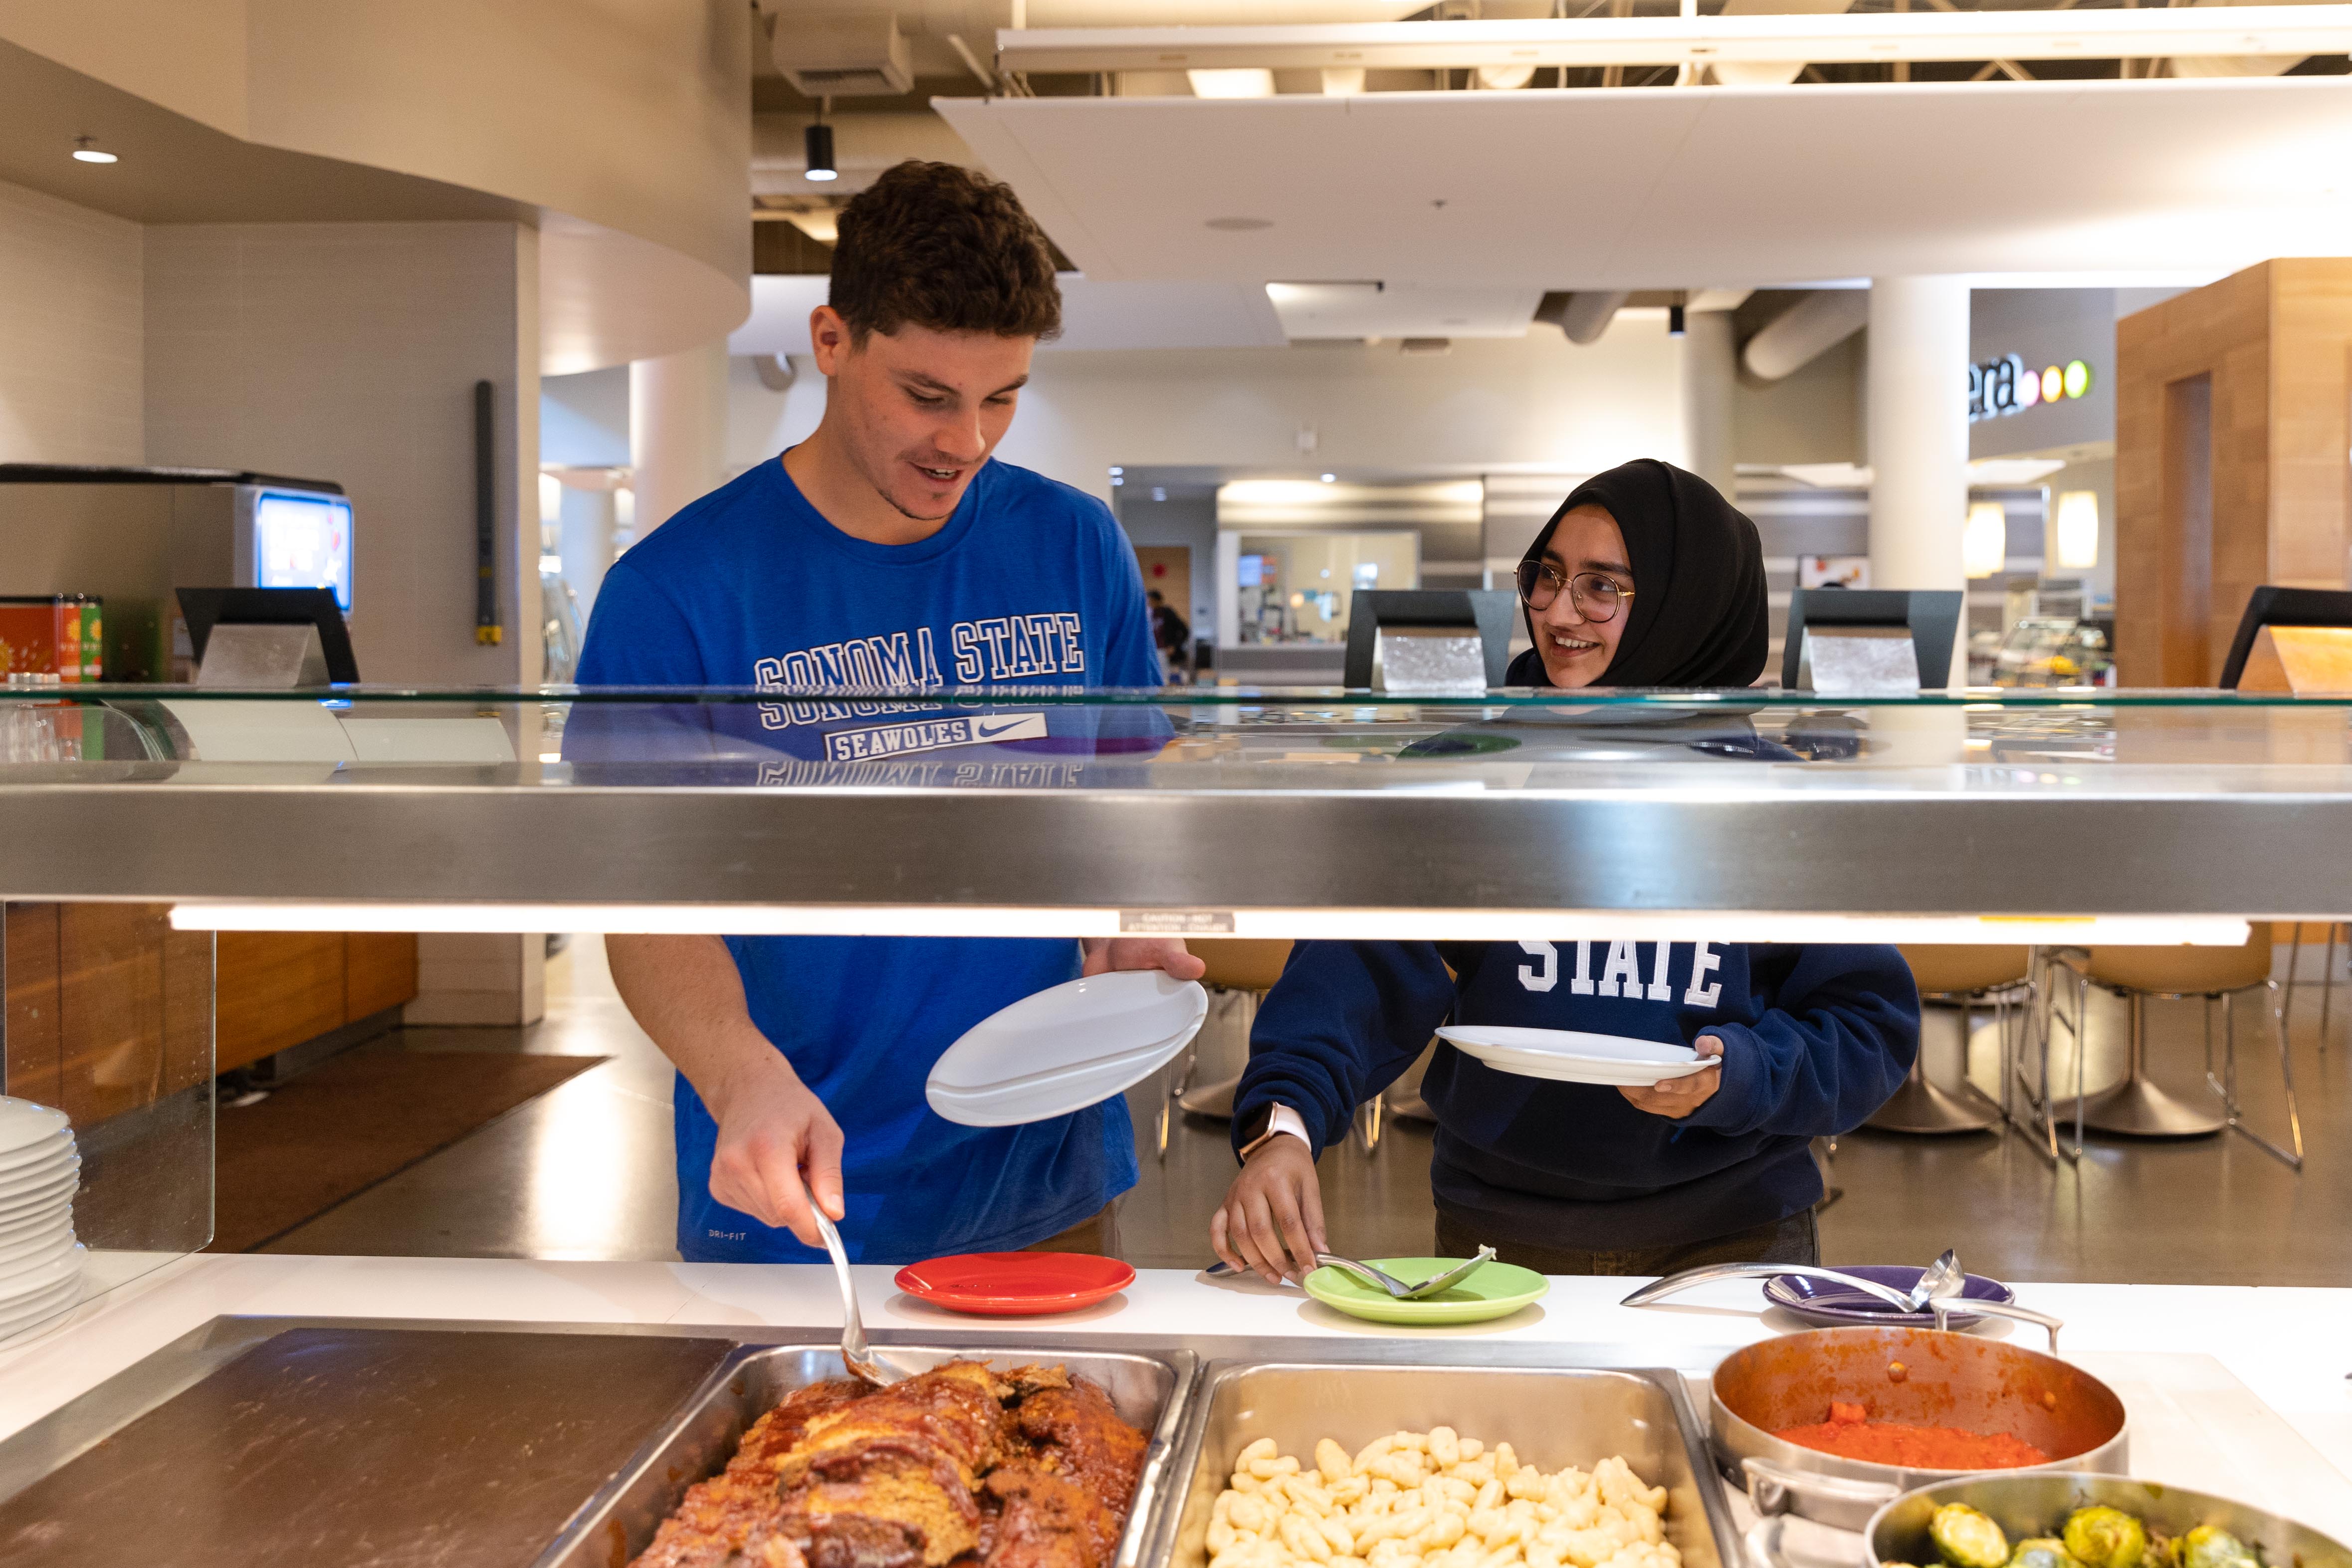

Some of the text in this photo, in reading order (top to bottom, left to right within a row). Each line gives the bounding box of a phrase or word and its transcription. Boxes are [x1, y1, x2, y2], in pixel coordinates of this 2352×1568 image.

[754, 613, 1085, 731] SONOMA STATE
[835, 721, 967, 761] SEAWOLES
[708, 1229, 747, 1241] DRI-FIT
